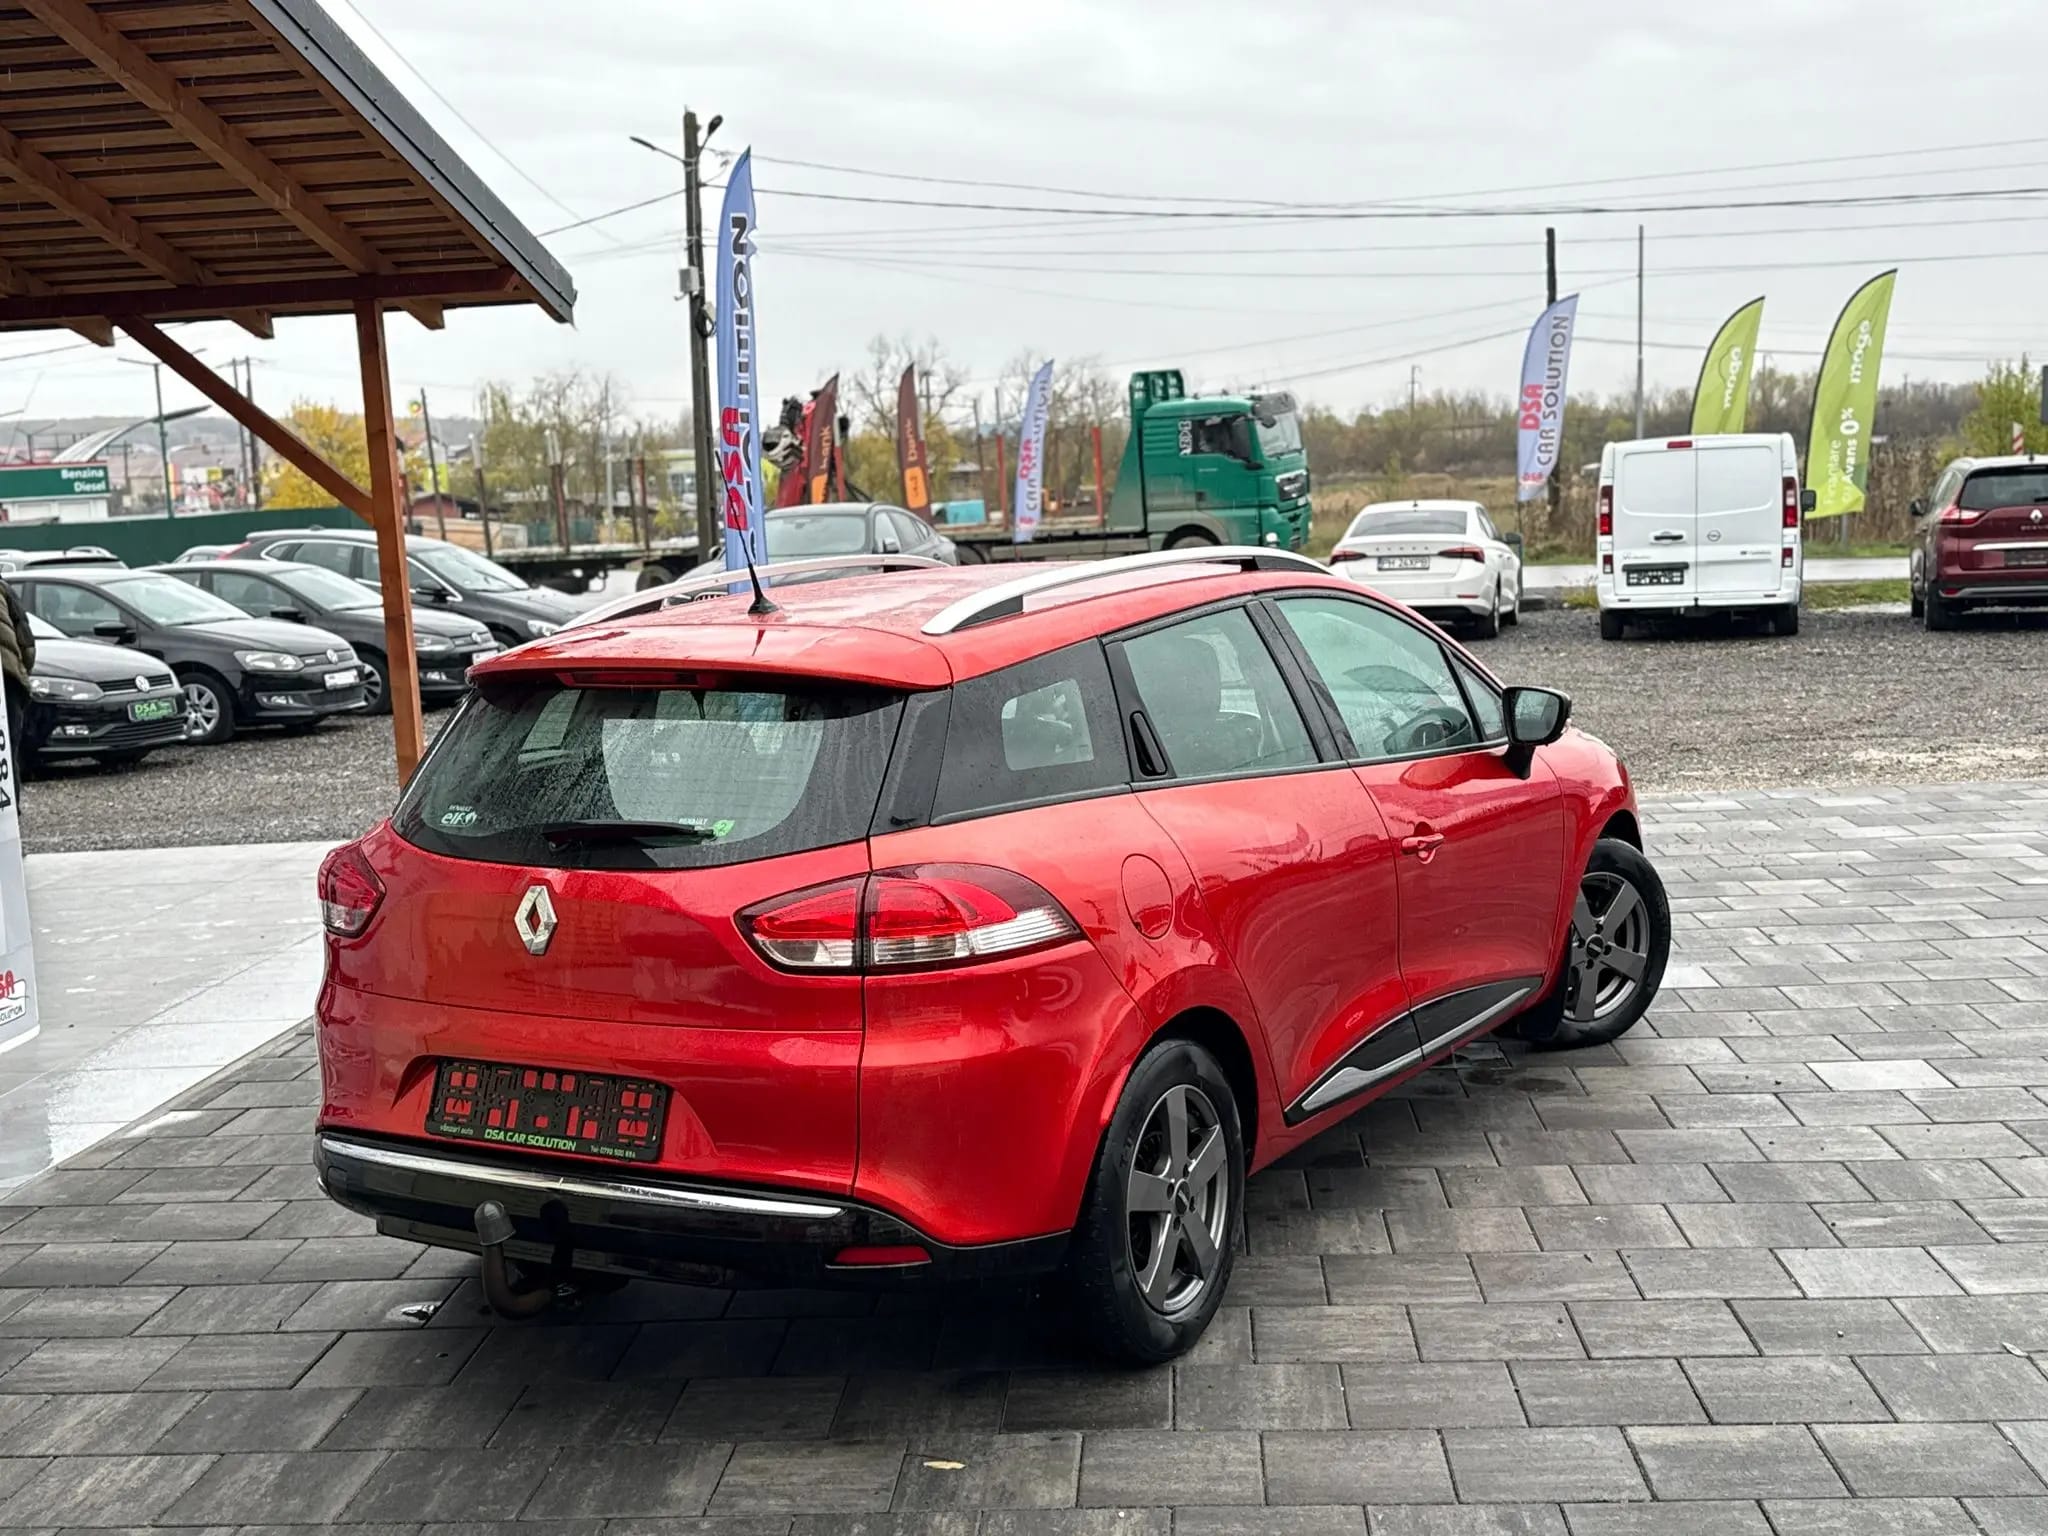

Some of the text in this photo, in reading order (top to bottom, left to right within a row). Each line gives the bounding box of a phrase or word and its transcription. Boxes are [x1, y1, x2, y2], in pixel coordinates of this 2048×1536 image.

[1850, 319, 1872, 384] mogo
[1519, 384, 1544, 431] DSA
[1537, 315, 1570, 467] CAR SOLUTION
[61, 468, 105, 479] Benzina
[721, 406, 748, 531] DSA
[73, 481, 106, 492] Diesel
[135, 702, 158, 713] DSA
[484, 1128, 577, 1151] DSA CAR SOLUTION
